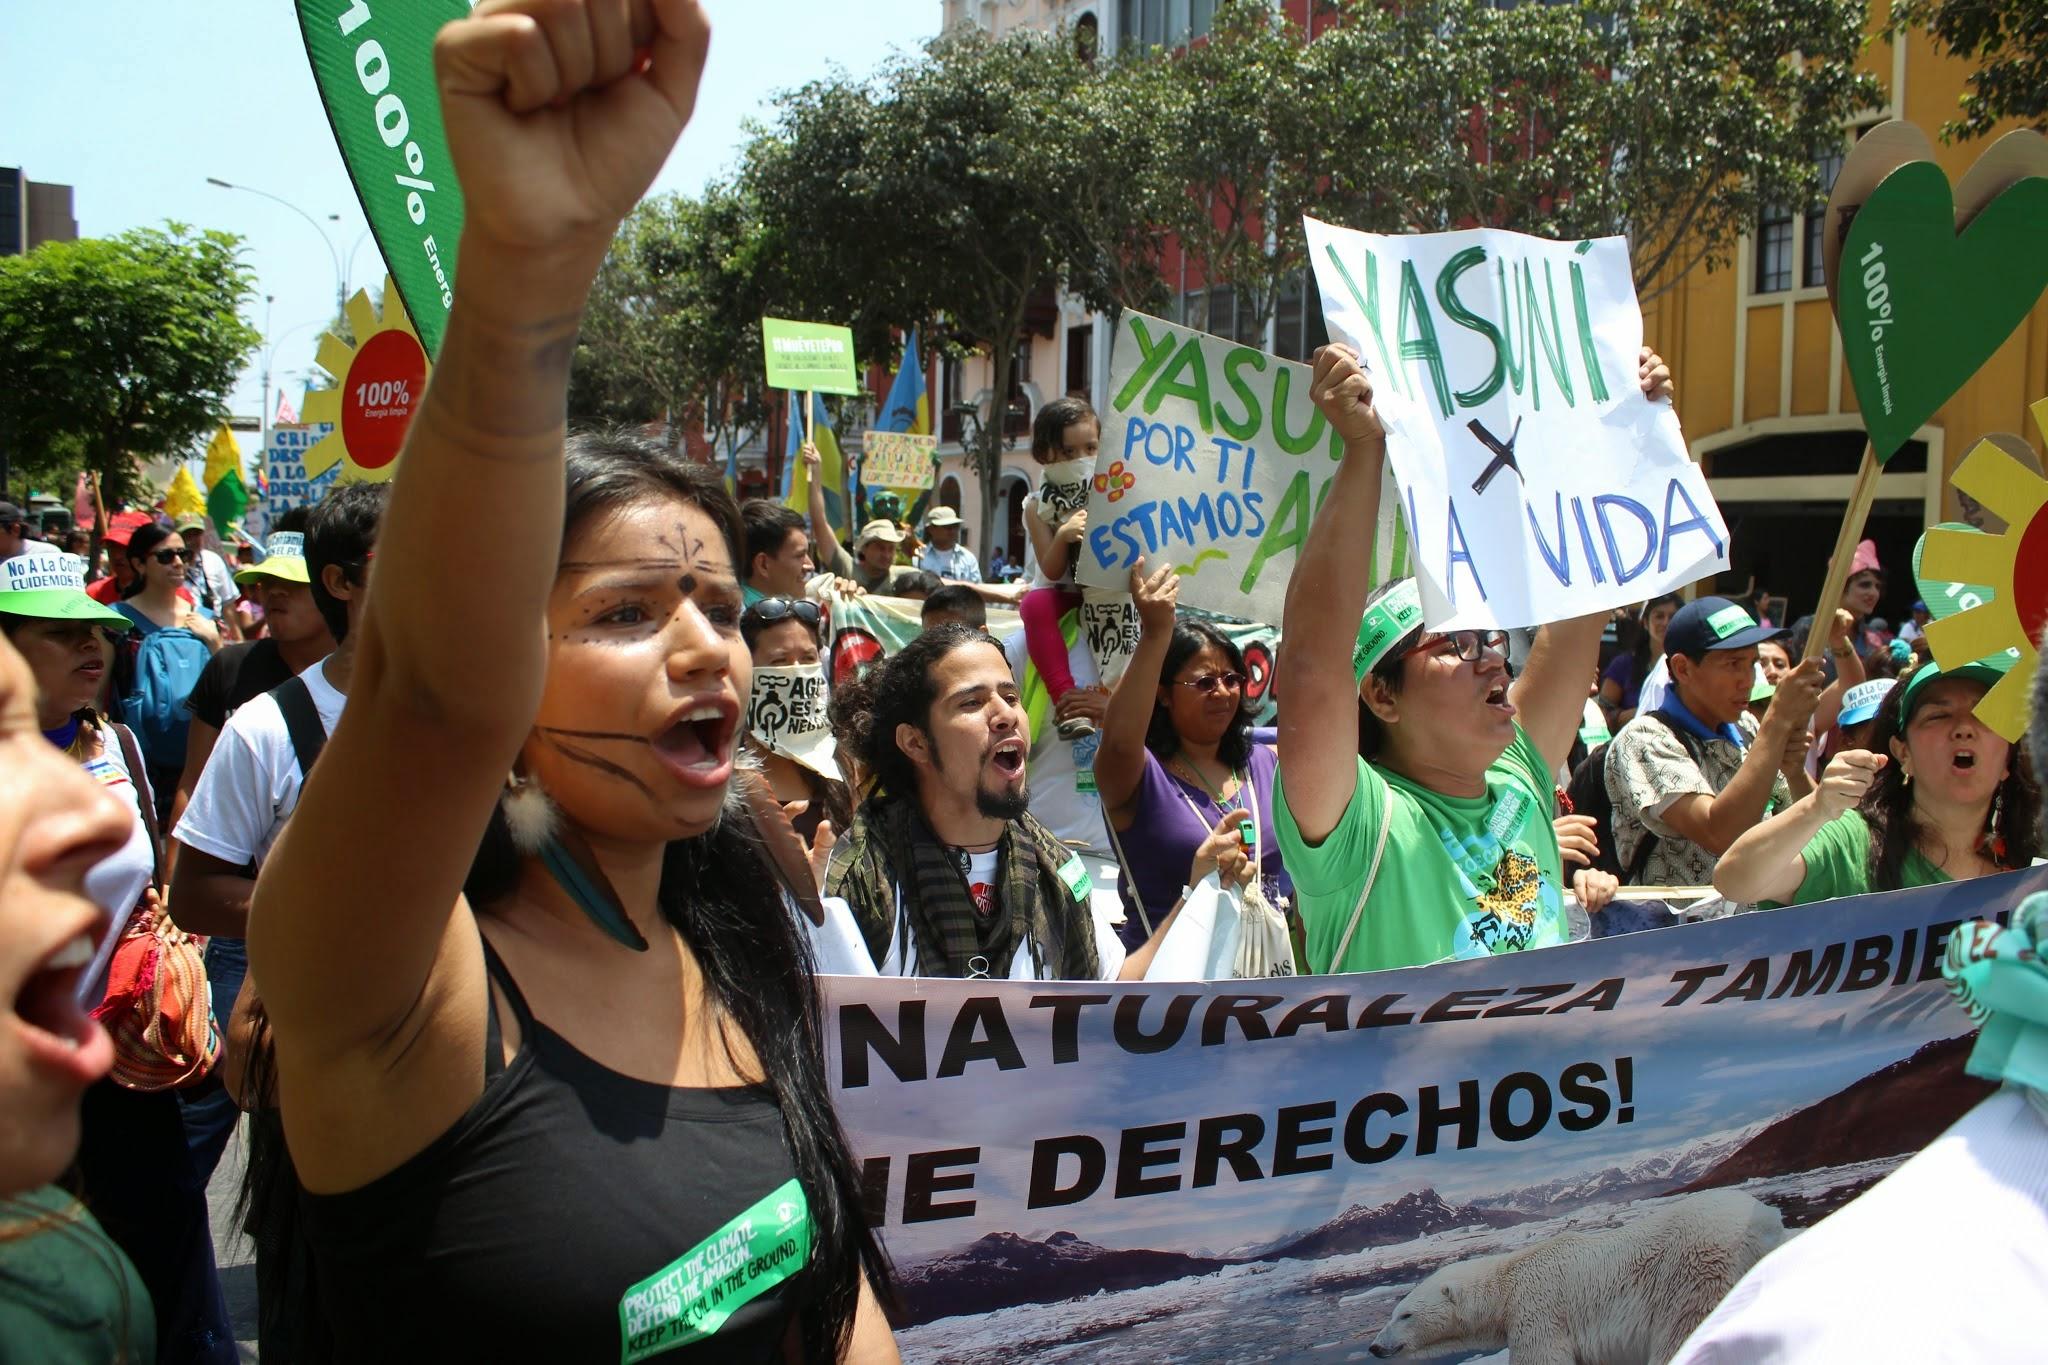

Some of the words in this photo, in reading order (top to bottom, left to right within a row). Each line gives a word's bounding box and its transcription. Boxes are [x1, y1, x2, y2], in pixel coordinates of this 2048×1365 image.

[423, 234, 453, 310] Energ
[1860, 241, 1894, 342] 100%
[1326, 240, 1609, 420] YASUNÍ
[356, 380, 410, 407] 100%
[1113, 316, 1344, 462] YASU
[269, 448, 306, 463] DES
[1123, 416, 1197, 475] POR
[1211, 437, 1256, 490] TI
[8, 561, 25, 577] No
[30, 559, 38, 573] A
[41, 558, 56, 572] La
[1090, 490, 1265, 570] ESTAMOS
[1525, 478, 1724, 587] VIDA
[11, 575, 73, 591] CUIDEMOS
[839, 977, 1625, 1089] NATURALEZA
[1661, 909, 2009, 1008] TAMBIE
[1027, 1056, 1635, 1210] DERECHOS!
[623, 1268, 684, 1317] PROTECT
[684, 1252, 706, 1277] THE
[628, 1324, 666, 1354] KEEP
[670, 1310, 696, 1336] THE
[711, 1286, 724, 1306] IN
[725, 1272, 747, 1293] THE
[749, 1239, 800, 1279] GROUND.
[628, 1295, 682, 1337] DEFEND
[681, 1280, 703, 1305] THE
